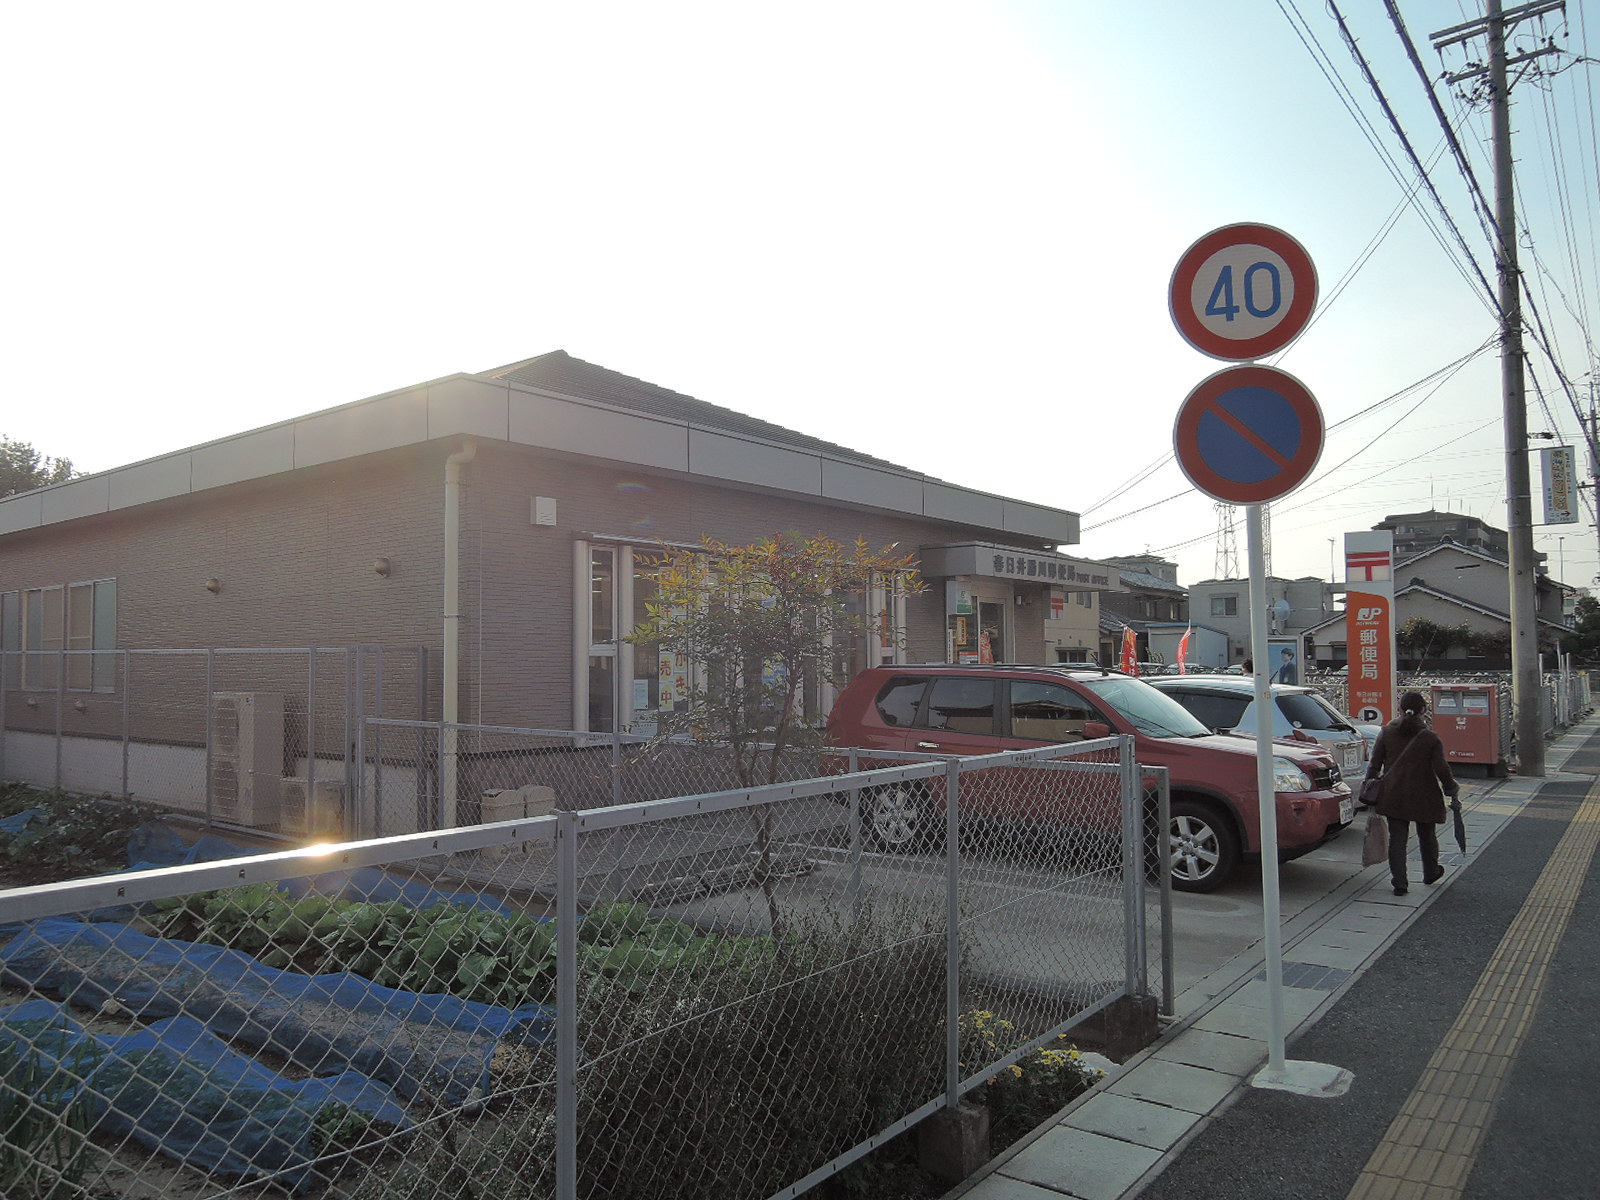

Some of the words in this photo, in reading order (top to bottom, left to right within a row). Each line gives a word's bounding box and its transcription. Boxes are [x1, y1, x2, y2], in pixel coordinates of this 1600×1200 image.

[1205, 261, 1281, 321] 40
[1360, 629, 1378, 680] 郵便局
[1363, 709, 1378, 722] P
